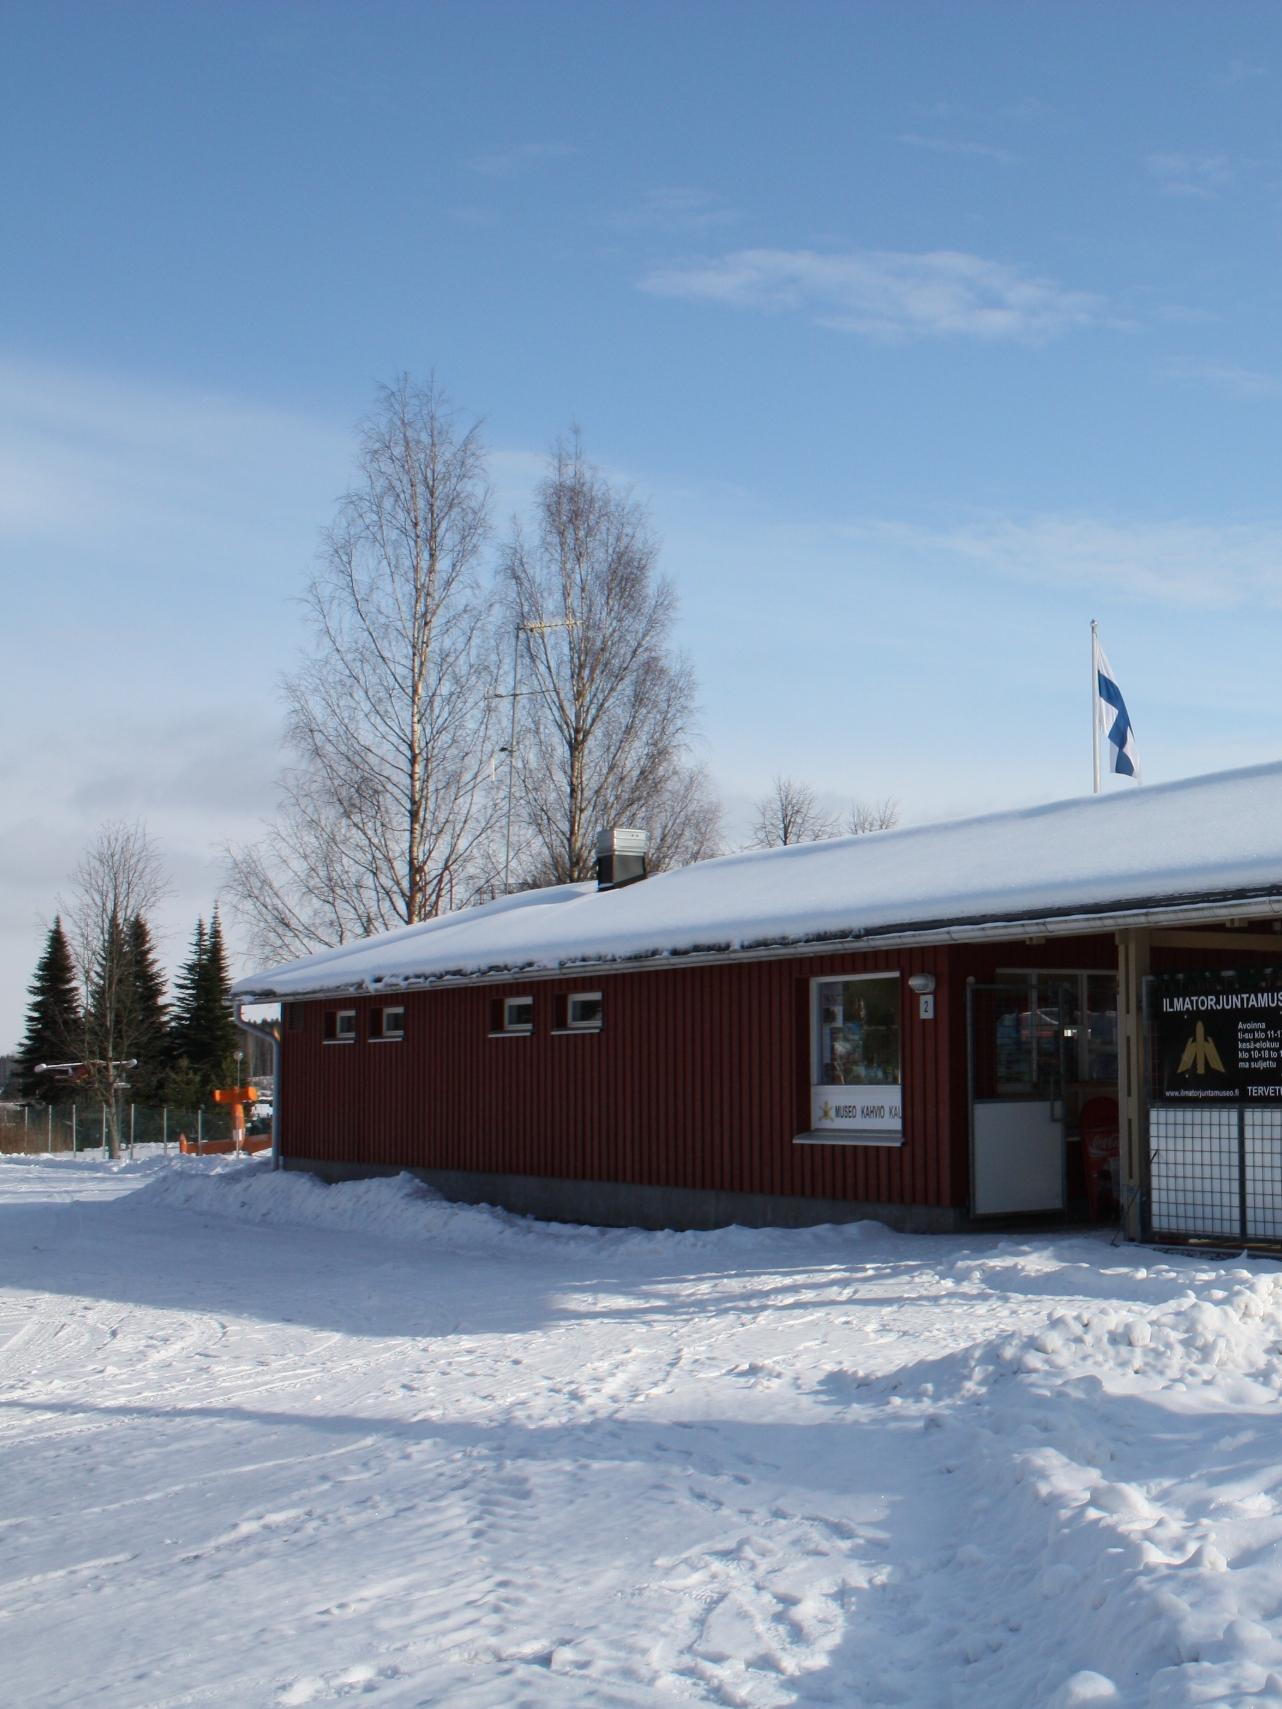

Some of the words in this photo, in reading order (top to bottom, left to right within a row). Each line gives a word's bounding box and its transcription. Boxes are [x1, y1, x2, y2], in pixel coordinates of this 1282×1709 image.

[923, 1000, 929, 1013] 2
[1237, 1021, 1266, 1030] Avoinna
[1237, 1031, 1254, 1039] ti-su
[1254, 1031, 1266, 1039] klo
[1238, 1040, 1280, 1049] kesä-elokuu
[1238, 1050, 1250, 1059] klo
[1250, 1049, 1269, 1059] 10-18
[1270, 1050, 1278, 1058] to
[1238, 1061, 1250, 1069] ma
[1250, 1060, 1277, 1070] suljettu
[1165, 1089, 1240, 1098] www.ilmatorjuntamuseo.fi
[835, 1105, 857, 1119] MUSEO
[861, 1105, 885, 1119] KAHVIO
